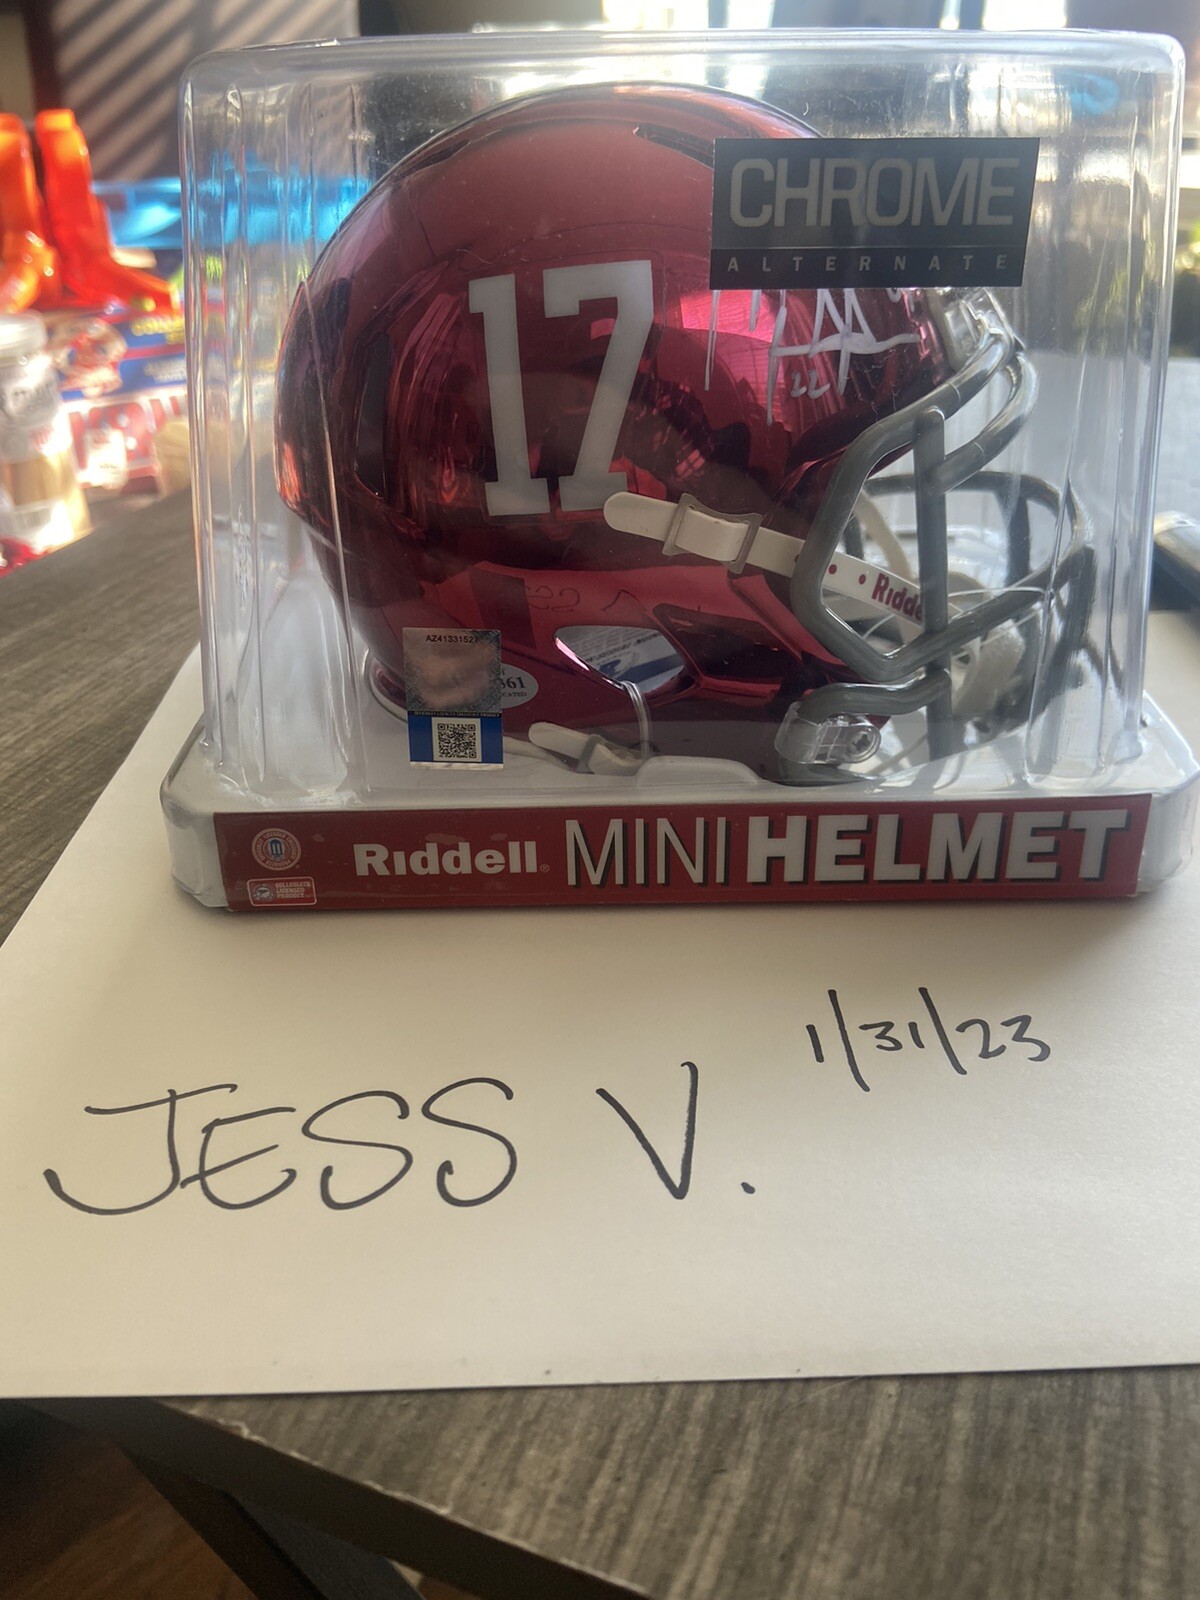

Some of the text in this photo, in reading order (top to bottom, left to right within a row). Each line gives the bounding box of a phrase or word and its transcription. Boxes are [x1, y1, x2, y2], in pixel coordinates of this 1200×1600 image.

[729, 157, 1020, 228] CHROME
[727, 254, 1007, 272] ALTERNATE
[468, 259, 654, 517] 17
[353, 841, 538, 876] Riddell
[565, 808, 1128, 886] MINI HELMET
[805, 986, 1051, 1092] 1/31/23
[43, 1061, 756, 1215] JESS V.
